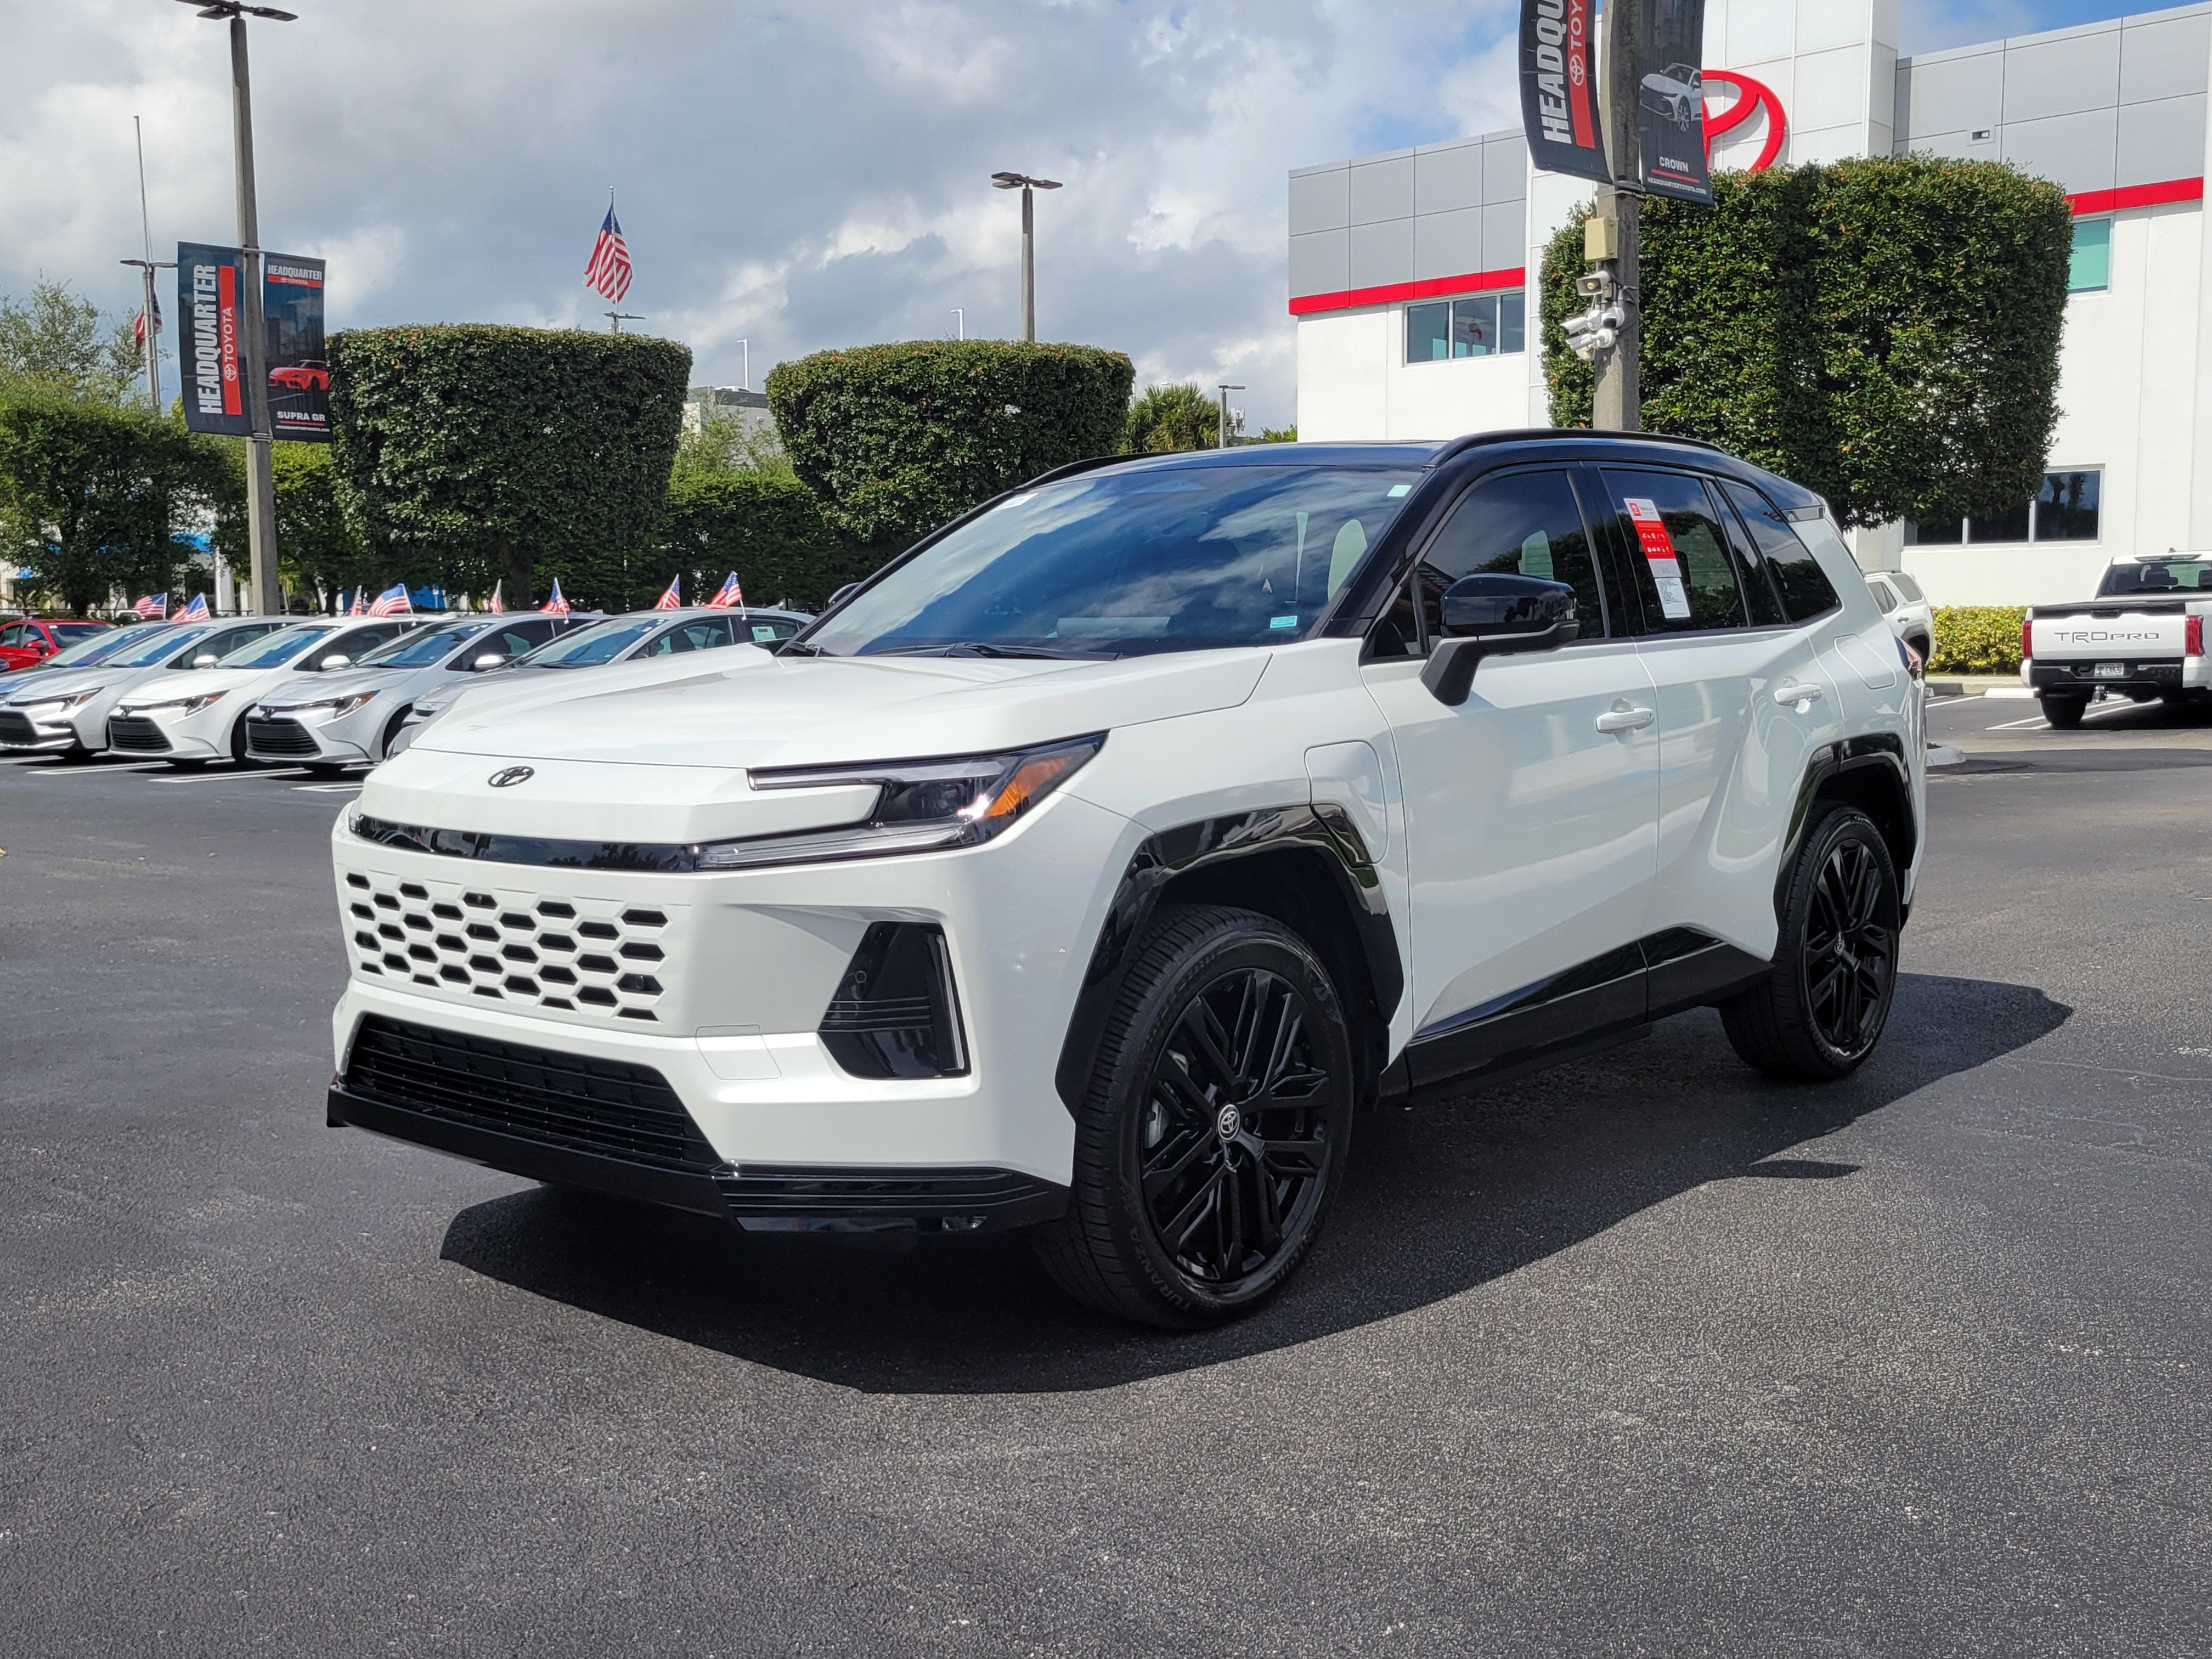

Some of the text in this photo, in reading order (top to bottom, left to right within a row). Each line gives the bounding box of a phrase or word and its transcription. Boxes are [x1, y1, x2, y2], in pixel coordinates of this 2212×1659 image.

[1659, 156, 1689, 173] CROWN
[268, 264, 323, 280] HEADQUARTER
[194, 264, 223, 414] HEADQUARTER
[222, 307, 236, 362] TOYOTA
[276, 411, 326, 421] SUPRA GR
[2054, 631, 2107, 644] TRD
[1129, 1226, 1193, 1310] TURANZA
